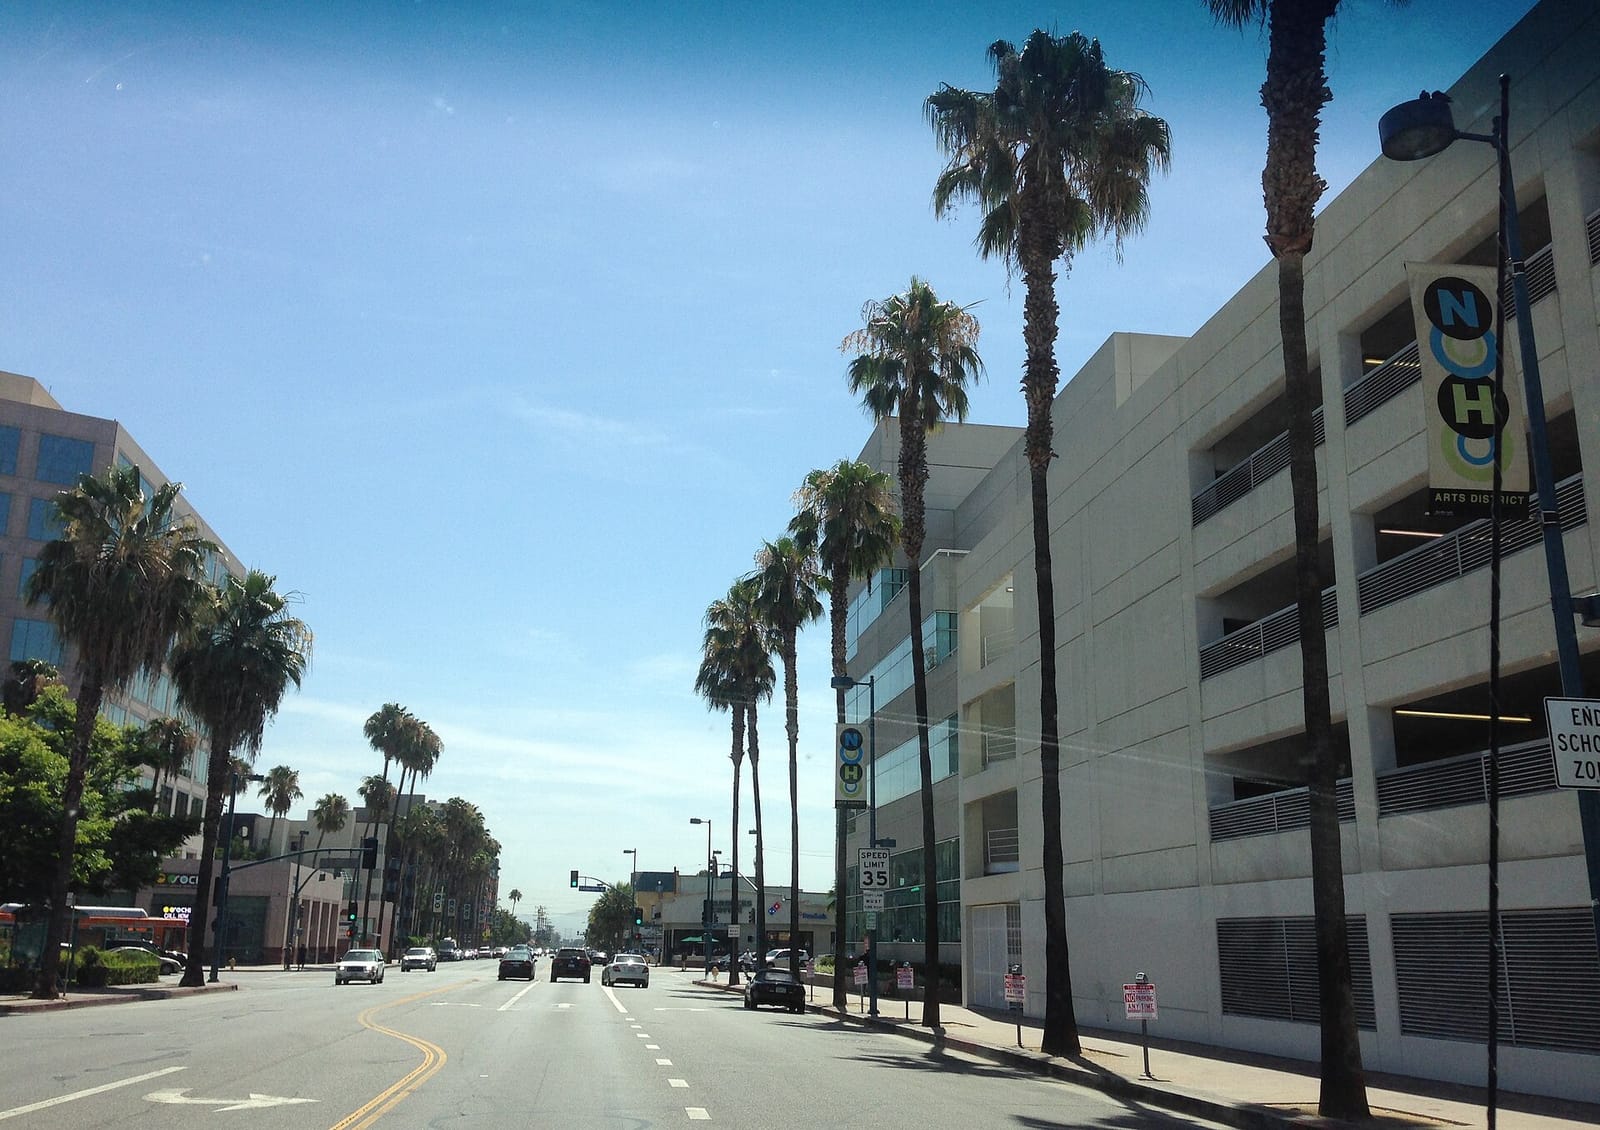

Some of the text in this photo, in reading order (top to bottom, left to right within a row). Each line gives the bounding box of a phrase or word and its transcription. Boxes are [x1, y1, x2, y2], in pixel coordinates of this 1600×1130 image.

[1435, 492, 1466, 503] ARTS
[1574, 761, 1600, 779] ZO
[861, 851, 888, 860] SPEED
[863, 861, 885, 869] LIMIT
[862, 870, 888, 886] 35
[1125, 993, 1136, 1002] NO
